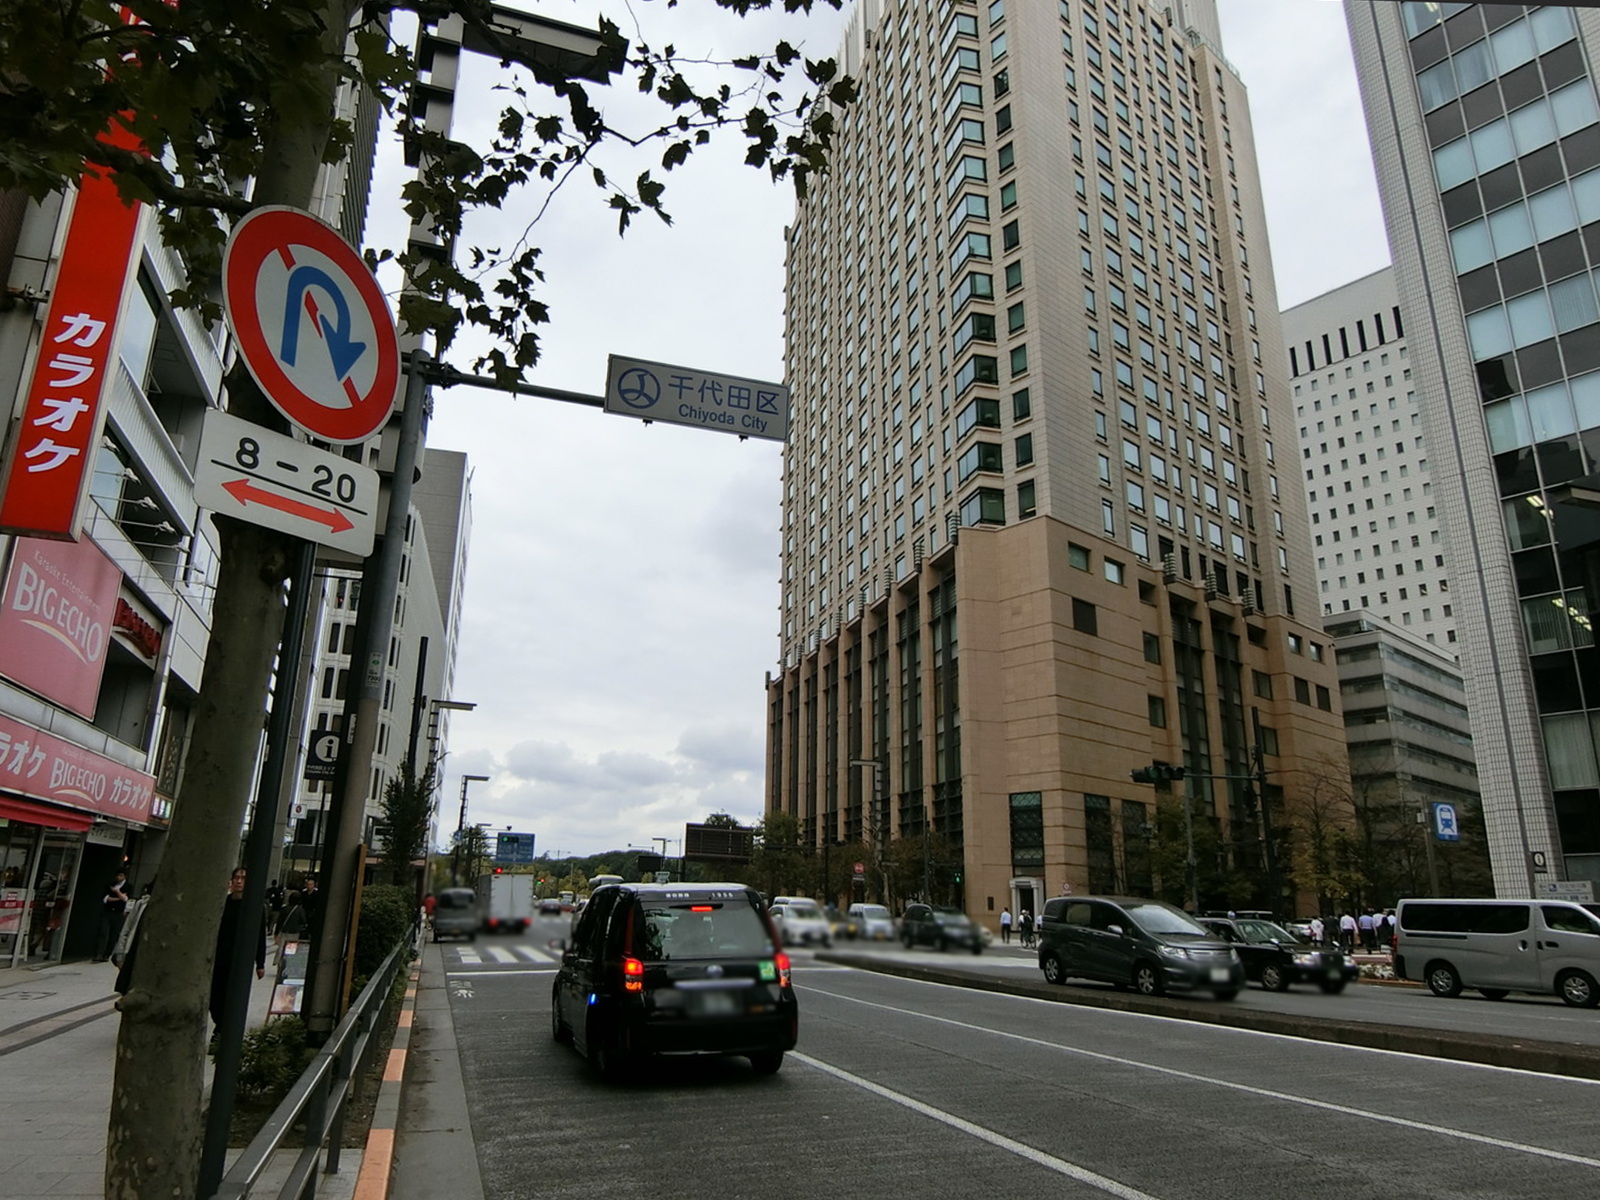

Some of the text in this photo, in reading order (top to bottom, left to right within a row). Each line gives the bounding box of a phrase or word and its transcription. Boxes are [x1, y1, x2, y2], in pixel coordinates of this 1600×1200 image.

[24, 311, 107, 473] カラオケ
[667, 373, 780, 416] 千代田区
[678, 403, 768, 433] Chiyoda City
[33, 548, 62, 582] Karaoke
[12, 561, 58, 621] BIG
[57, 595, 104, 663] ECHO
[49, 757, 76, 789] BIG
[76, 768, 107, 802] ECHO
[109, 775, 152, 811] カラオケ
